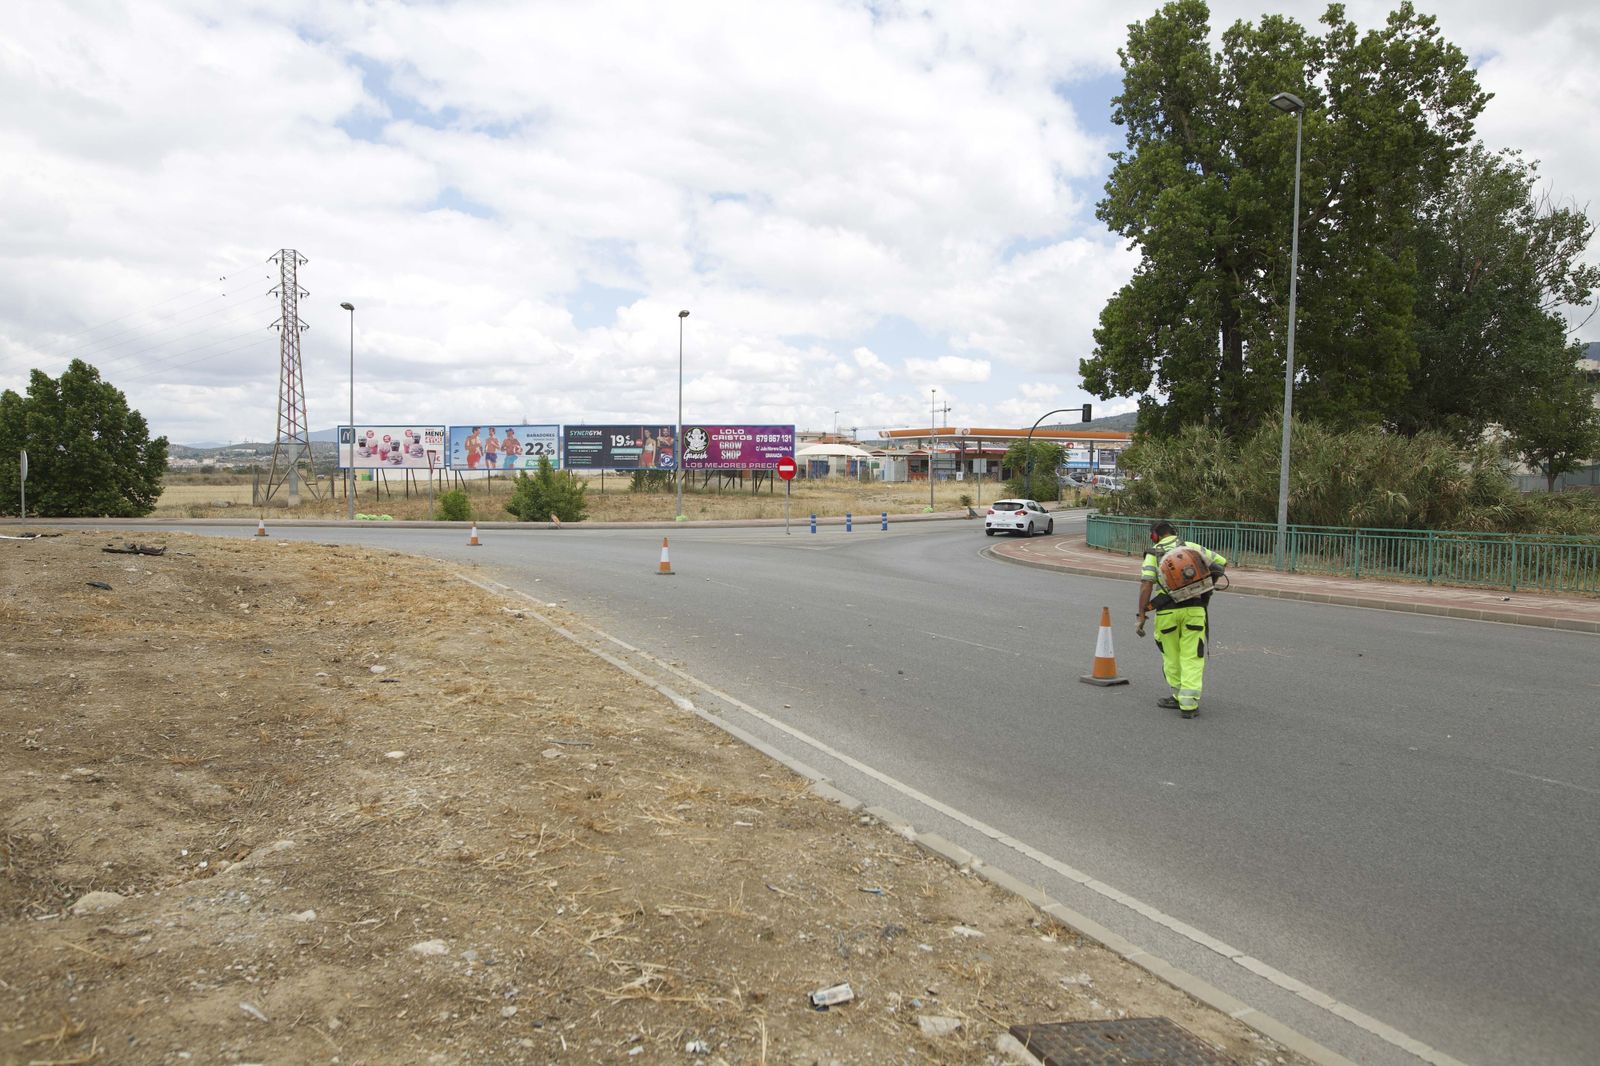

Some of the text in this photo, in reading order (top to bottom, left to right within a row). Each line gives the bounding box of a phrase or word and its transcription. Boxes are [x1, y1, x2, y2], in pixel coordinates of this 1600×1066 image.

[610, 435, 624, 446] 19
[525, 442, 544, 455] 22
[721, 450, 741, 459] SHOP
